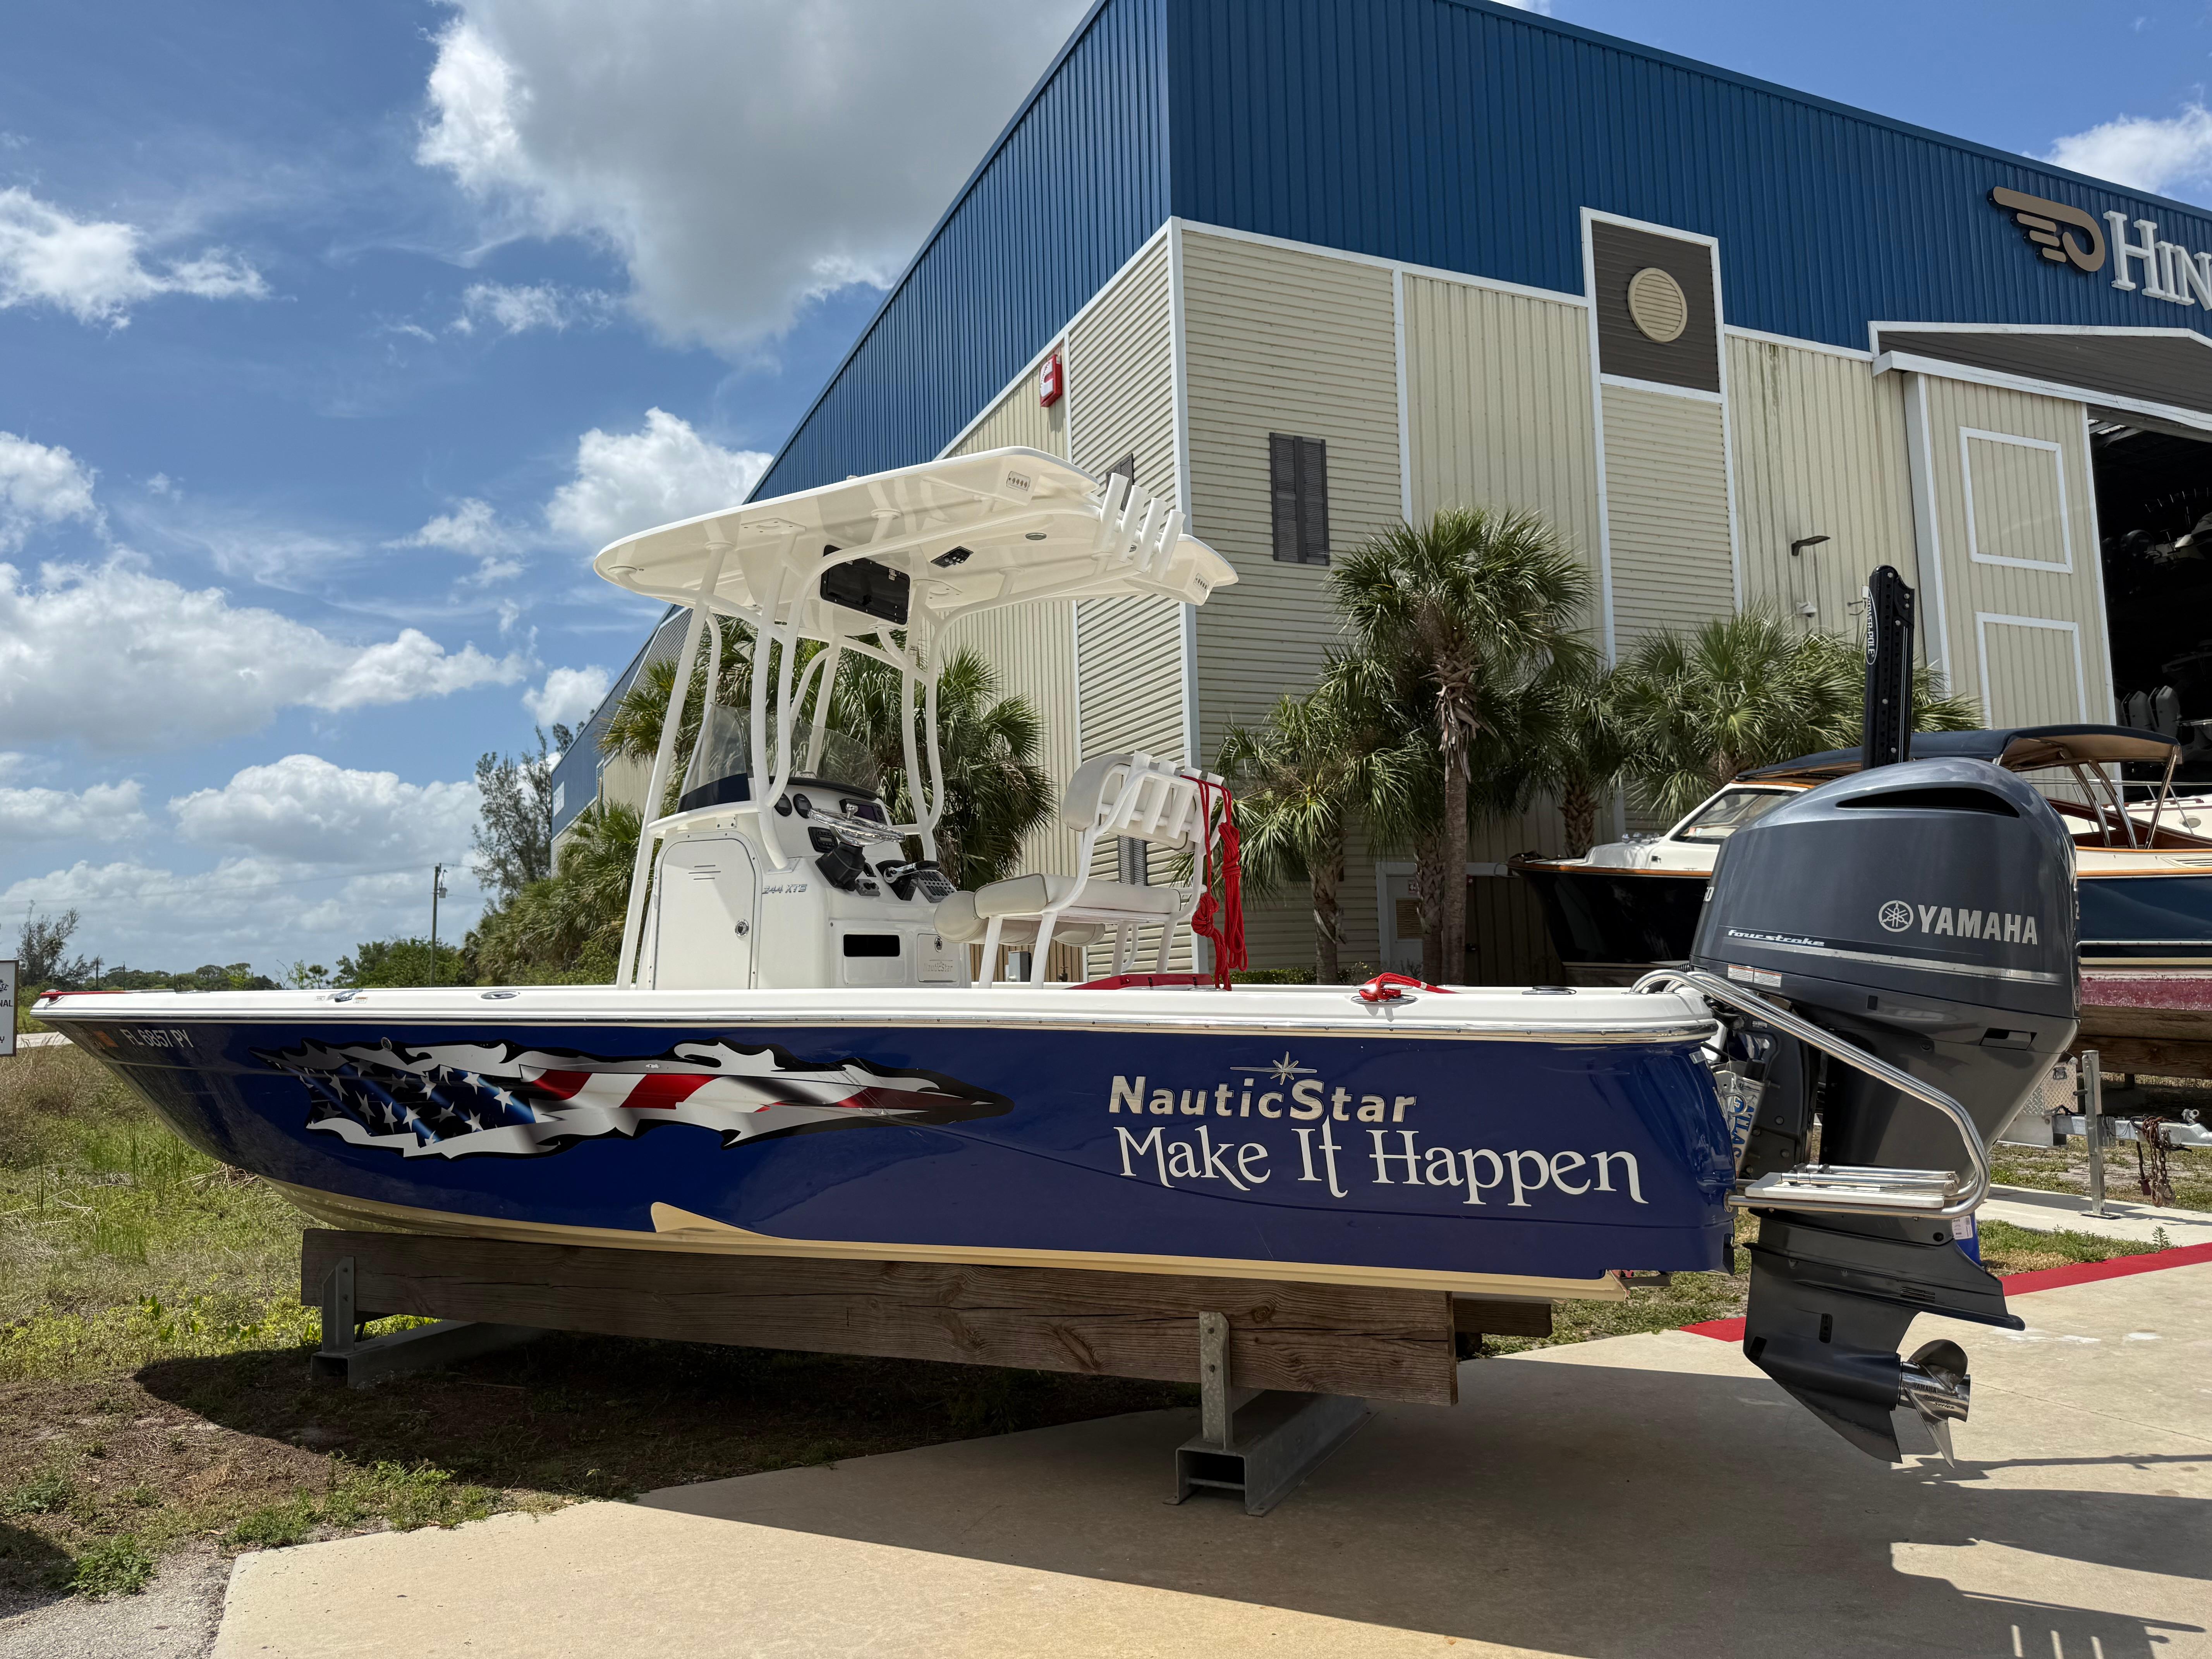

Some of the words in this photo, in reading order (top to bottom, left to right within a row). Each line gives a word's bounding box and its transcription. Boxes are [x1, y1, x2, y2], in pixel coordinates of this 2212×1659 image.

[2103, 210, 2212, 311] HIN
[785, 884, 807, 893] XTS
[1918, 904, 2037, 945] YAMAHA
[119, 1029, 145, 1046] FL
[137, 1029, 174, 1048] 6857
[169, 1029, 194, 1048] PY
[1108, 1075, 1417, 1123] NauticStar
[1113, 1125, 1271, 1191] Make
[1291, 1115, 1348, 1198] It
[1365, 1129, 1649, 1207] Happen
